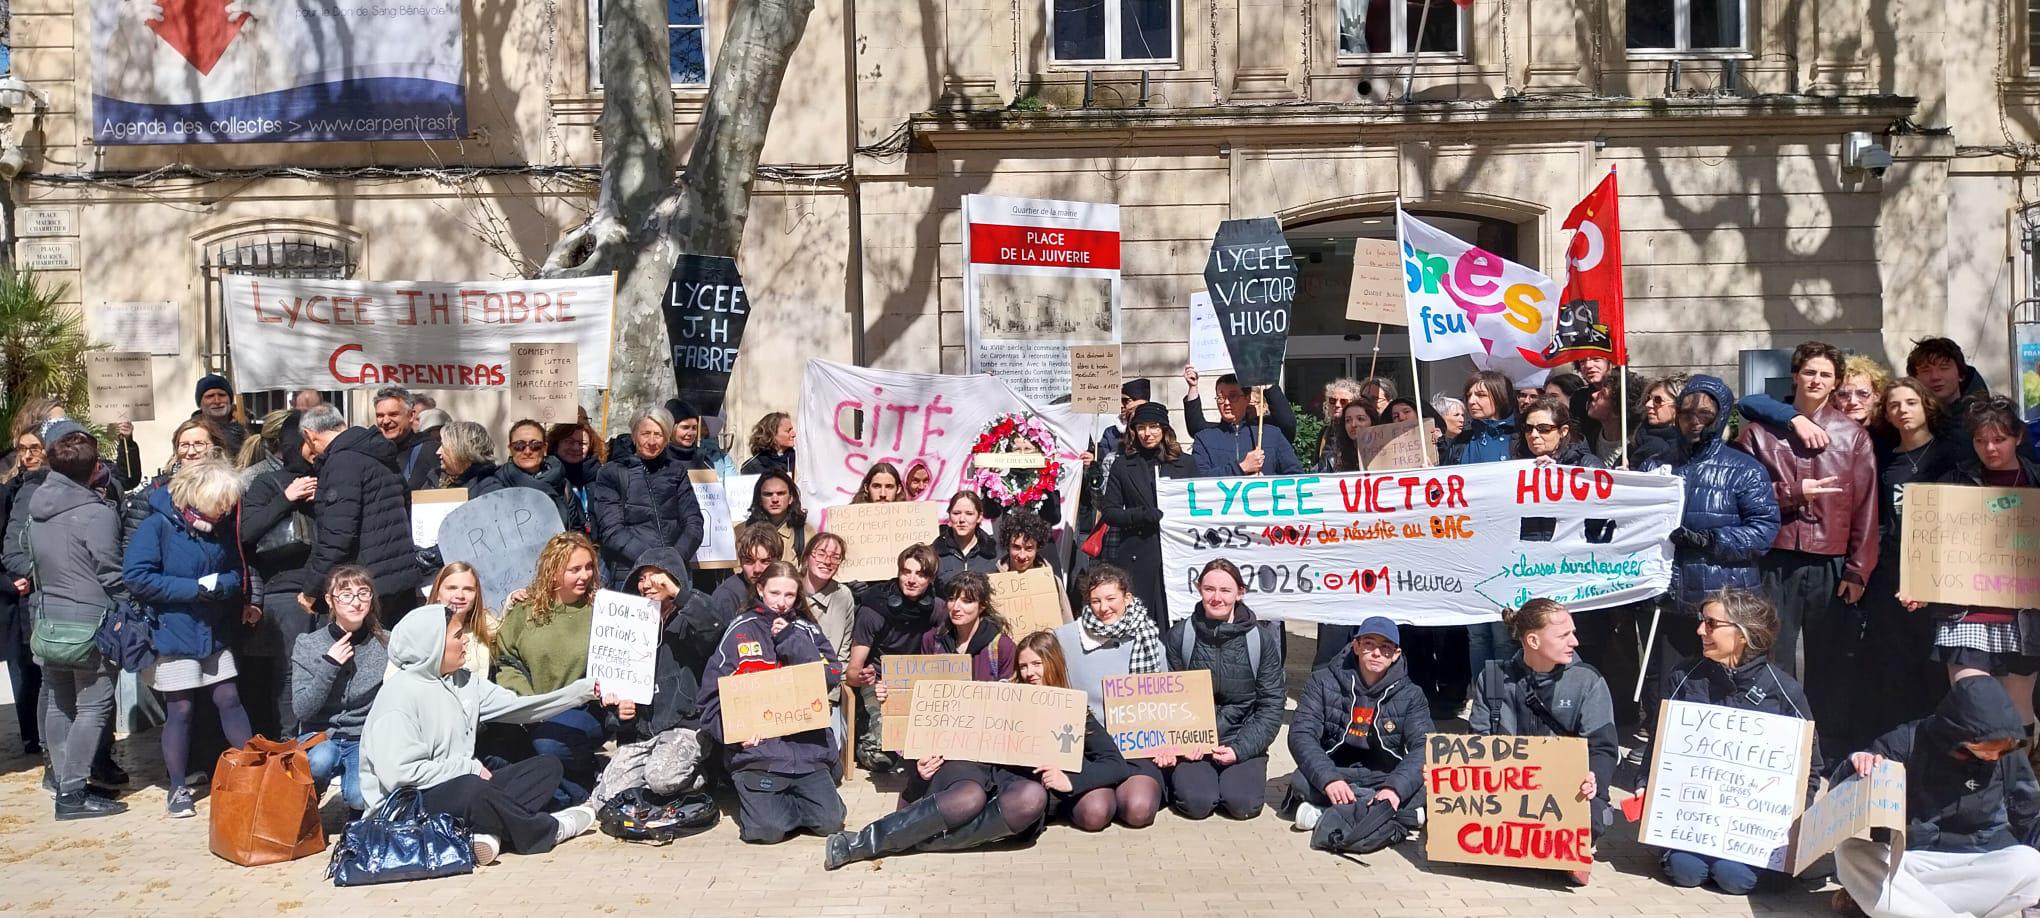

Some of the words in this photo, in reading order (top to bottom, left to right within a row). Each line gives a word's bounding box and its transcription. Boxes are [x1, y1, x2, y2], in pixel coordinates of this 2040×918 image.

[101, 117, 166, 140] Agenda
[173, 116, 202, 134] des
[209, 114, 282, 135] collectes
[1012, 205, 1039, 216] Quartier
[1050, 208, 1057, 216] la
[1057, 208, 1078, 218] mairie
[1027, 231, 1065, 246] PLACE
[1001, 247, 1017, 260] DE
[1021, 248, 1036, 261] LA
[1039, 249, 1091, 264] JUIVERIE
[1215, 240, 1293, 274] LYCÉE
[671, 281, 745, 315] LYCEE
[1215, 276, 1296, 307] VICTOR
[251, 281, 376, 329] LYCEE
[458, 288, 578, 326] FABRE
[682, 315, 728, 343] J.H
[1229, 309, 1287, 336] HUGO
[1420, 305, 1467, 344] fsu
[328, 343, 507, 387] CARPENTRAS
[517, 348, 555, 356] COMMENT
[673, 344, 739, 373] FABRE
[1187, 476, 1324, 518] LYCEE
[1339, 473, 1469, 516] VICTOR
[1516, 467, 1614, 505] HUGO
[1911, 489, 1937, 507] LE
[858, 506, 900, 517] BESOIN
[906, 504, 921, 514] DE
[1317, 522, 1340, 545] de
[1343, 519, 1398, 543] réussite
[1402, 521, 1424, 539] au
[1430, 515, 1475, 540] BAC
[1511, 553, 1557, 579] classes
[1010, 577, 1027, 593] DE
[1396, 568, 1463, 594] Heures
[1931, 573, 1964, 588] VOS
[595, 623, 637, 643] OPTIONS
[1105, 676, 1135, 698] MES
[774, 707, 813, 726] RAGE
[913, 714, 976, 729] ESSAYEZ
[984, 715, 1025, 733] DONC
[1108, 704, 1137, 725] MES
[1680, 707, 1766, 736] LYCÉES
[1136, 729, 1166, 750] CHOIX
[1429, 735, 1486, 765] PAS
[1491, 736, 1529, 762] DE
[1681, 734, 1793, 771] SACRIFIÉS
[1430, 765, 1543, 794] FUTURE
[1434, 794, 1503, 818] SANS
[1518, 793, 1563, 822] LA
[1682, 787, 1709, 801] FIN
[1719, 793, 1740, 808] DES
[1676, 808, 1721, 827] POSTES
[1457, 821, 1594, 865] CULTURE
[1670, 825, 1717, 848] ÉLÈVES
